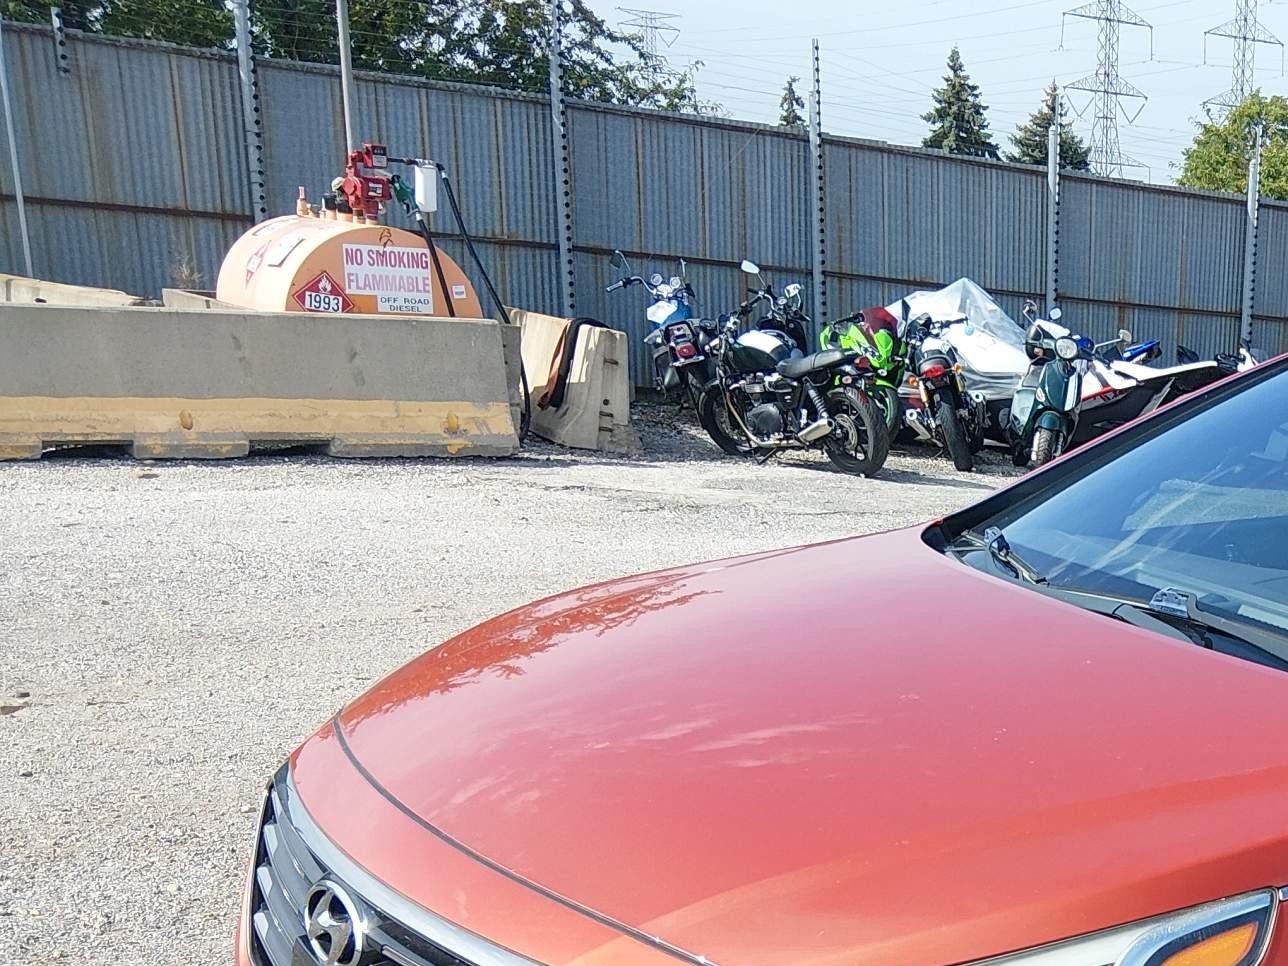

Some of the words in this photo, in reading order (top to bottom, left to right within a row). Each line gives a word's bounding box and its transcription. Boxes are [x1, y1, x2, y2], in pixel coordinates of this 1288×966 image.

[345, 248, 363, 266] NO
[367, 249, 429, 270] SMOKING
[347, 273, 430, 294] FLAMMABLE
[307, 293, 341, 313] 1993
[380, 296, 399, 305] OFF
[403, 297, 430, 305] ROAD
[389, 304, 423, 313] DIESEL
